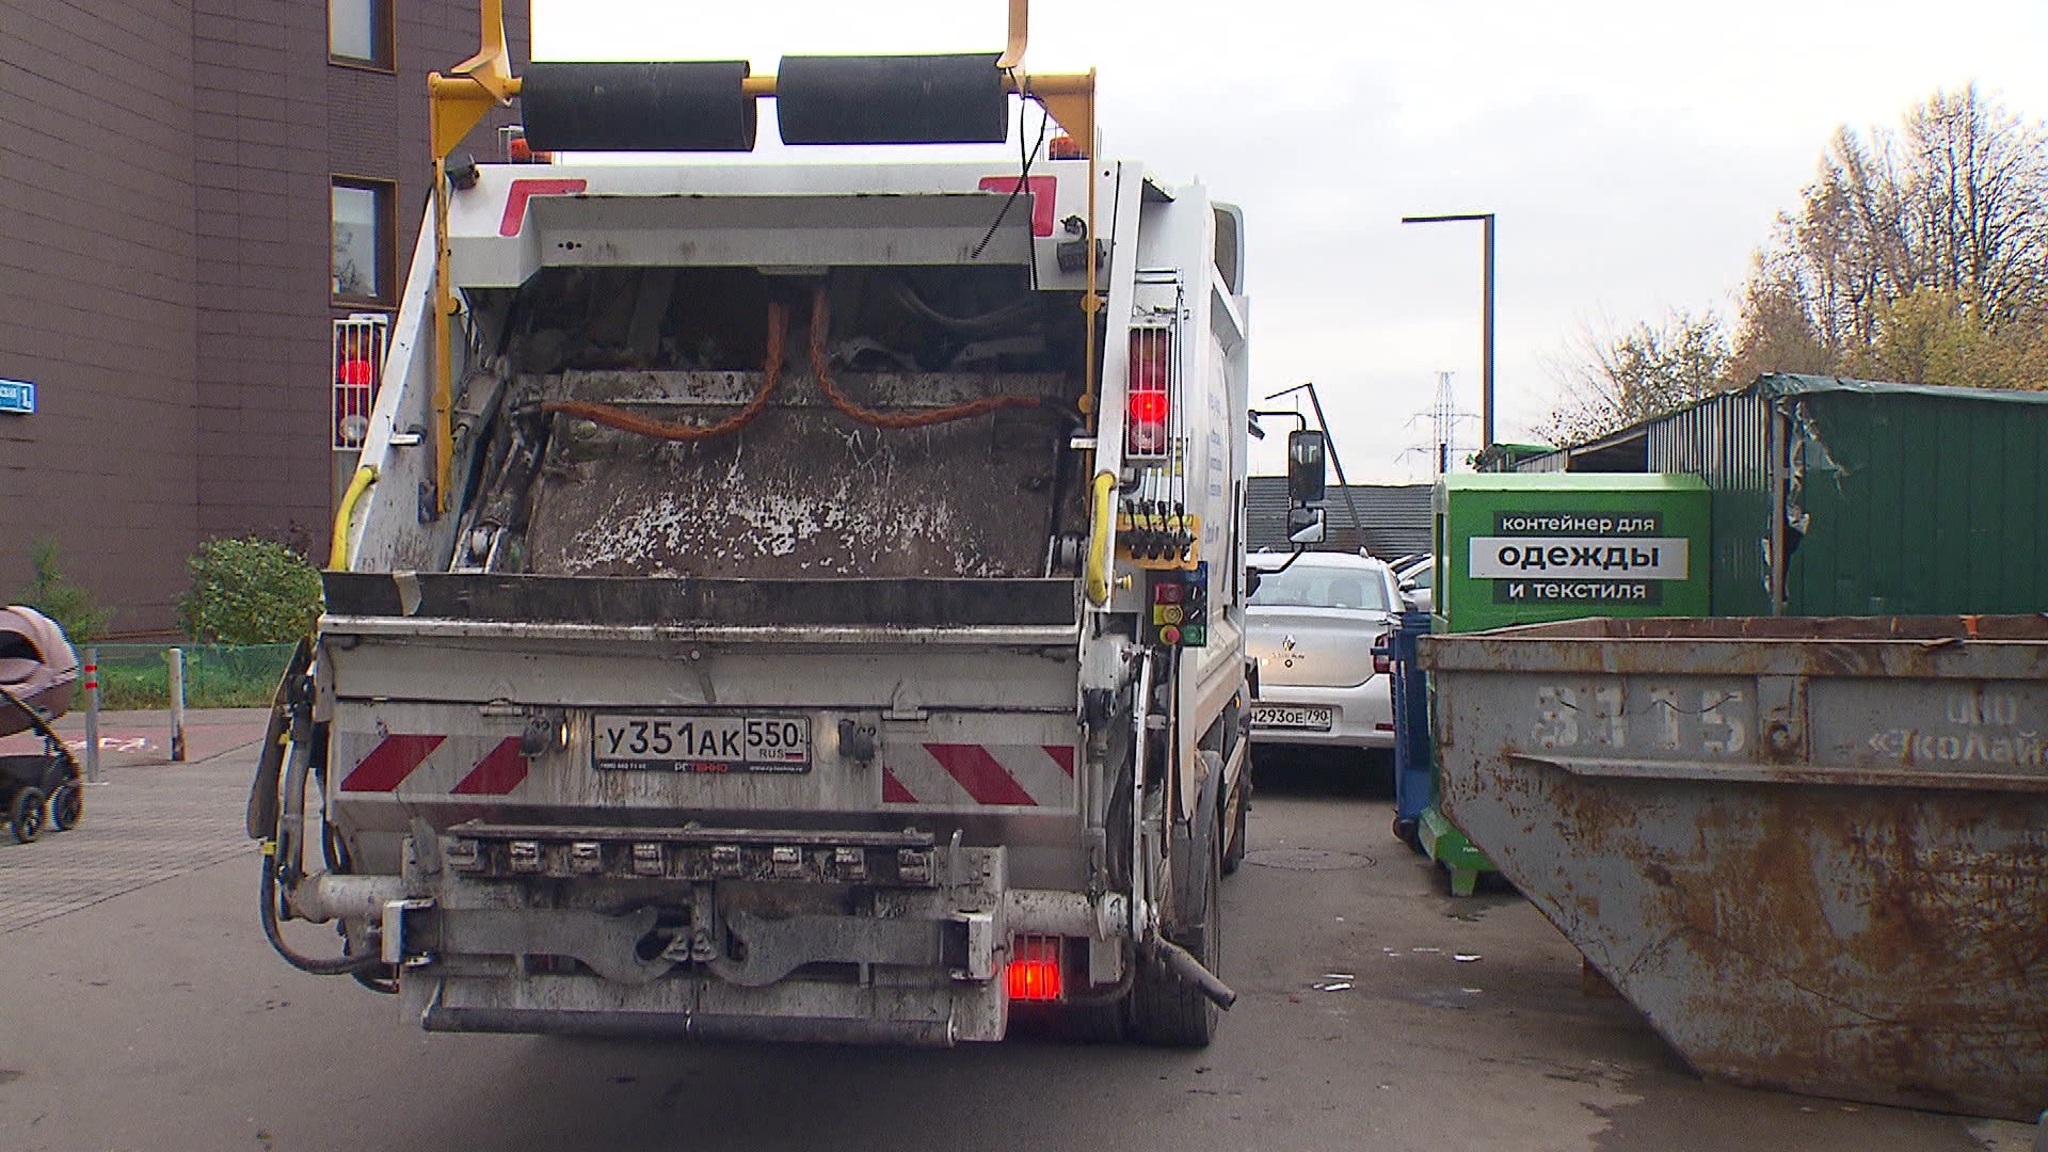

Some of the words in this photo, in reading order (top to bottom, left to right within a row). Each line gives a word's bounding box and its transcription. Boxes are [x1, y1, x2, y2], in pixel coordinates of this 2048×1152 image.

[1502, 515, 1613, 534] контейнер
[1616, 517, 1655, 532] для
[1498, 546, 1660, 571] одежды
[1509, 584, 1525, 598] и
[1533, 584, 1647, 599] текстиля
[607, 721, 741, 756] У351АК
[747, 721, 799, 748] 550
[759, 749, 785, 759] RUS
